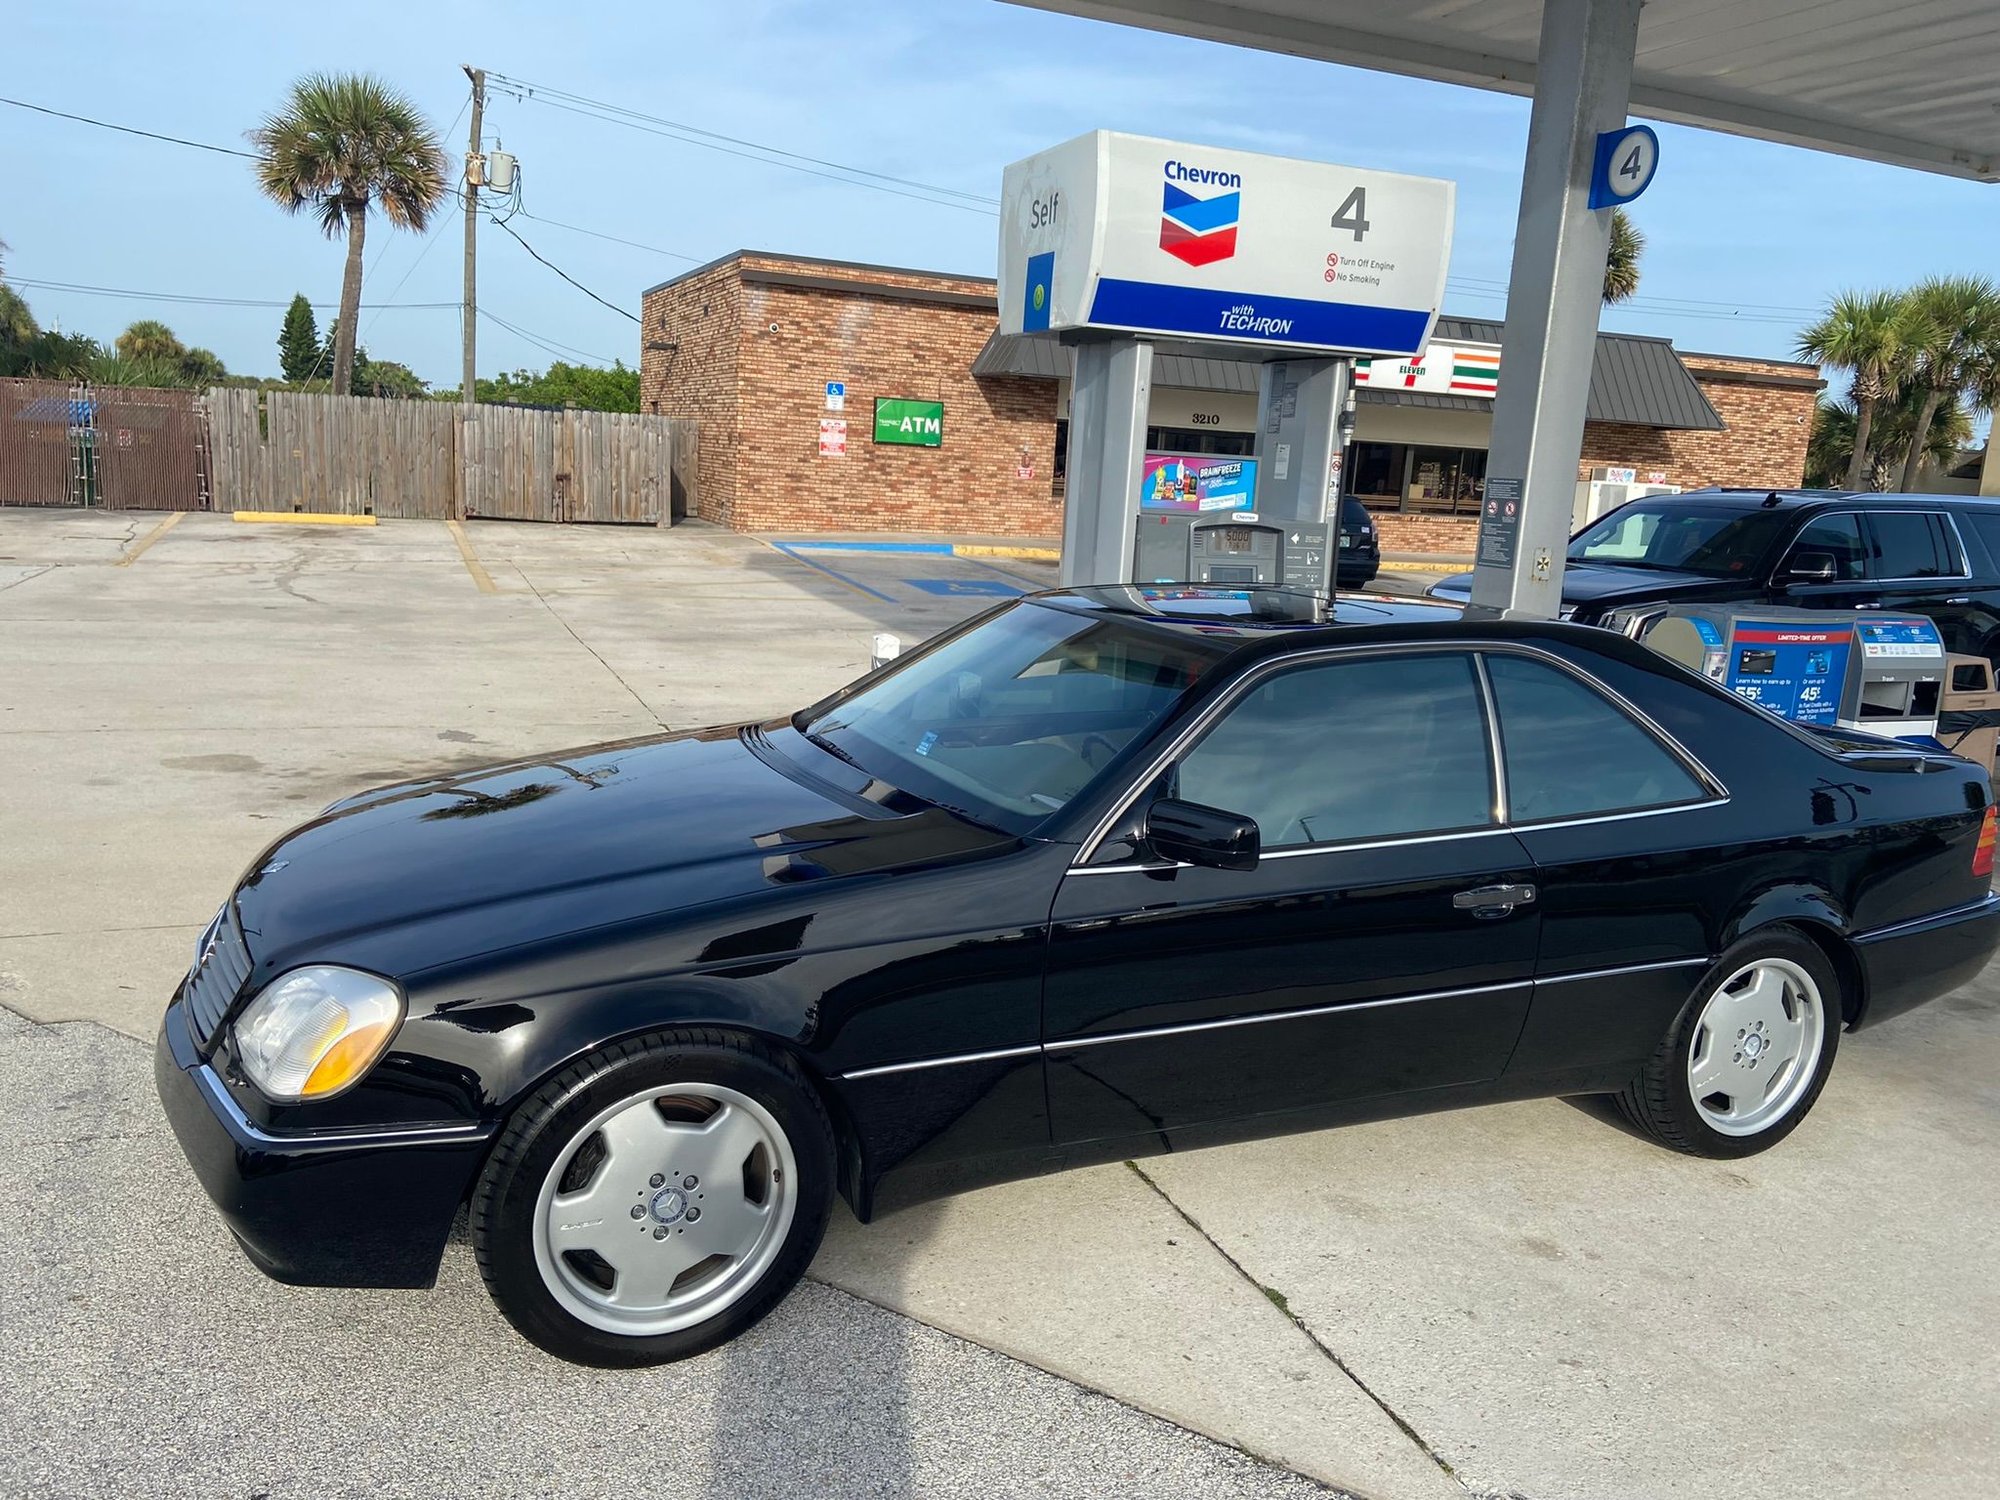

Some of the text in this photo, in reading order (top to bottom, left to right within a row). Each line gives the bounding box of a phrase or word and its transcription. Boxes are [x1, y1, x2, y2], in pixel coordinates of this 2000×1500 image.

[1620, 145, 1641, 179] 4
[1164, 160, 1241, 188] Chevron
[1031, 192, 1059, 229] Self
[1331, 187, 1370, 241] 4
[1340, 256, 1395, 271] Turn Off Engine
[1337, 272, 1380, 286] No Smoking
[1232, 304, 1254, 315] with
[1220, 311, 1293, 336] TECHRON
[900, 416, 940, 435] ATM
[1192, 413, 1220, 425] 3210
